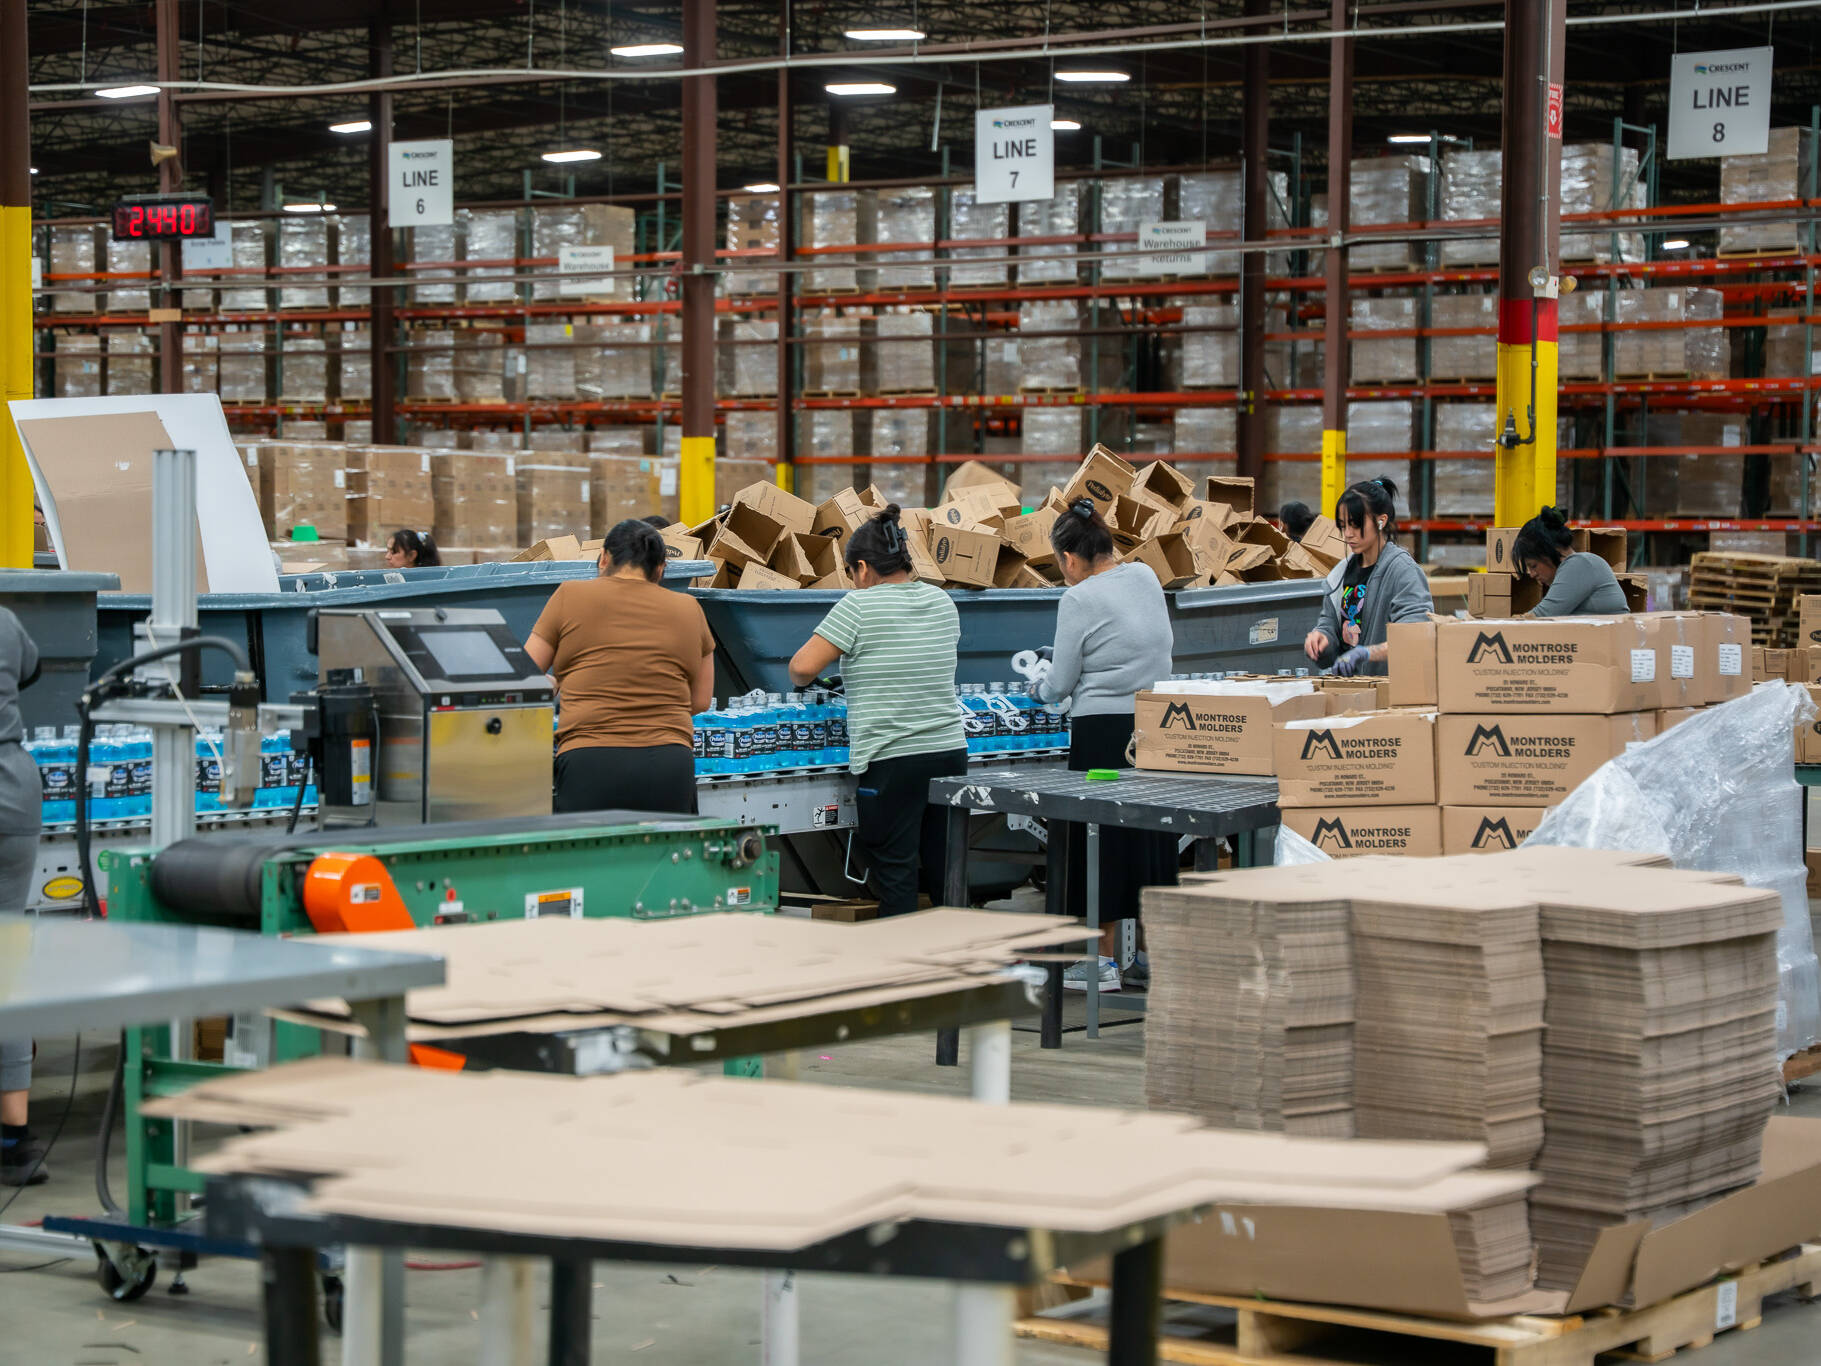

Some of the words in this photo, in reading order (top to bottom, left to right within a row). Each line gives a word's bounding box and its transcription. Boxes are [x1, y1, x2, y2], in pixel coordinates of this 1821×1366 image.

[1709, 63, 1750, 74] CRESCENT
[1692, 86, 1750, 110] LINE
[1004, 119, 1036, 128] CRESCENT
[1712, 122, 1726, 143] 8
[993, 139, 1037, 160] LINE
[403, 169, 439, 188] LINE
[1009, 171, 1020, 189] 7
[416, 198, 425, 215] 6
[1144, 239, 1202, 250] Warehouse
[1512, 643, 1578, 653] MONTROSE
[1517, 655, 1574, 664] MOLDERS
[1195, 713, 1247, 724] MONTROSE
[1199, 723, 1243, 733] MOLDERS
[1341, 738, 1402, 748] MONTROSE
[1510, 737, 1576, 747] MONTROSE
[1346, 749, 1398, 759] MOLDERS
[1515, 748, 1571, 758] MOLDERS
[1350, 827, 1411, 838] MONTROSE
[1355, 838, 1407, 849] MOLDERS
